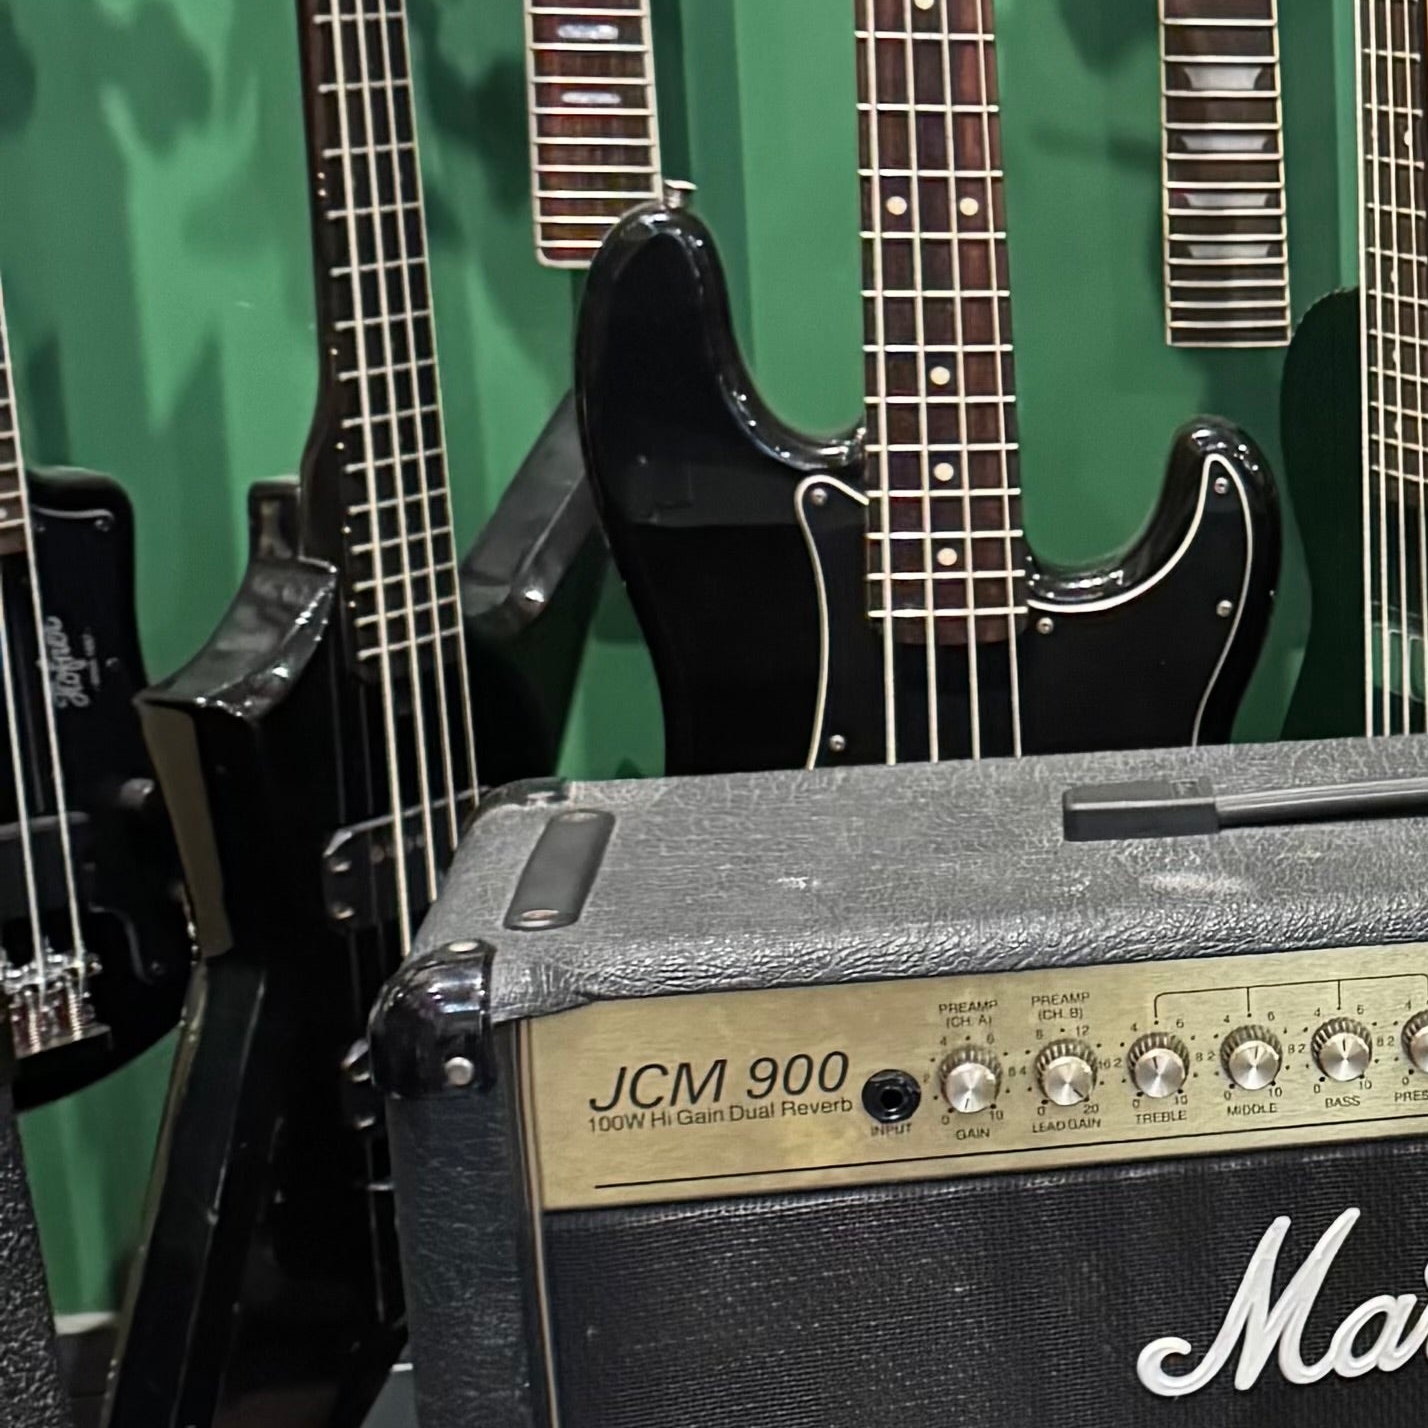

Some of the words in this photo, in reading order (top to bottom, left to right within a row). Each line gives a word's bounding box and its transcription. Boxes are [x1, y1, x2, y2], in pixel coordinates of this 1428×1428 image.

[1031, 991, 1090, 1007] PREAMP
[938, 999, 998, 1015] PREAMP
[1075, 1025, 1090, 1038] 12
[588, 1058, 728, 1113] JCM
[746, 1050, 850, 1100] 900
[1083, 1103, 1100, 1115] 20
[1325, 1095, 1361, 1109] BASS
[587, 1112, 646, 1134] 100W
[651, 1108, 672, 1129] Hi
[677, 1106, 725, 1127] Gain
[729, 1100, 775, 1122] Dual
[781, 1096, 853, 1118] Reverb
[1135, 1110, 1188, 1125] TREBLE
[1227, 1103, 1279, 1117] MIDDLE
[870, 1122, 913, 1138] INPUT
[1032, 1120, 1067, 1134] LEAD
[1068, 1117, 1102, 1131] GAIN
[956, 1127, 991, 1141] GAIN
